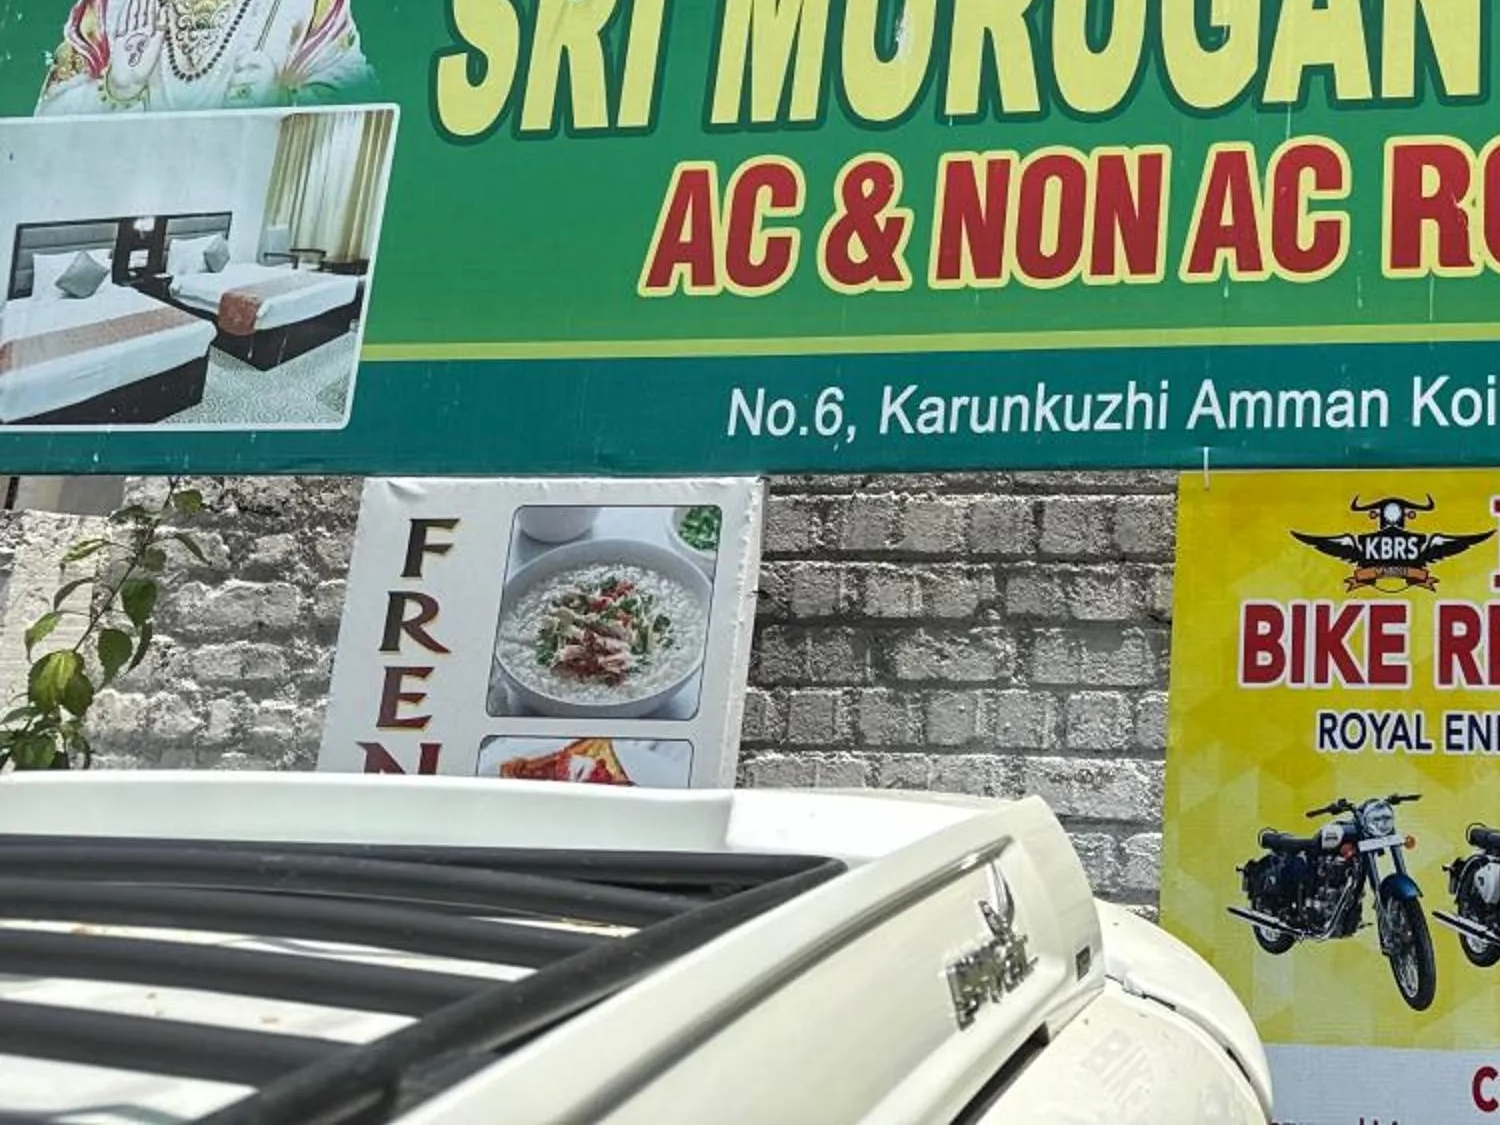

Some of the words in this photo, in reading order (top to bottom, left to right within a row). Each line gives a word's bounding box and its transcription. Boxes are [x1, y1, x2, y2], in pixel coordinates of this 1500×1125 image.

[639, 157, 806, 300] AC
[819, 152, 914, 296] &
[928, 144, 1171, 292] NON
[1180, 135, 1352, 286] AC
[727, 387, 856, 444] No.6,
[879, 380, 1169, 435] Karunkuzhi
[1186, 378, 1390, 430] Amman
[1365, 536, 1419, 560] KBRS
[1240, 601, 1410, 690] BIKE
[1317, 711, 1432, 752] ROYAL
